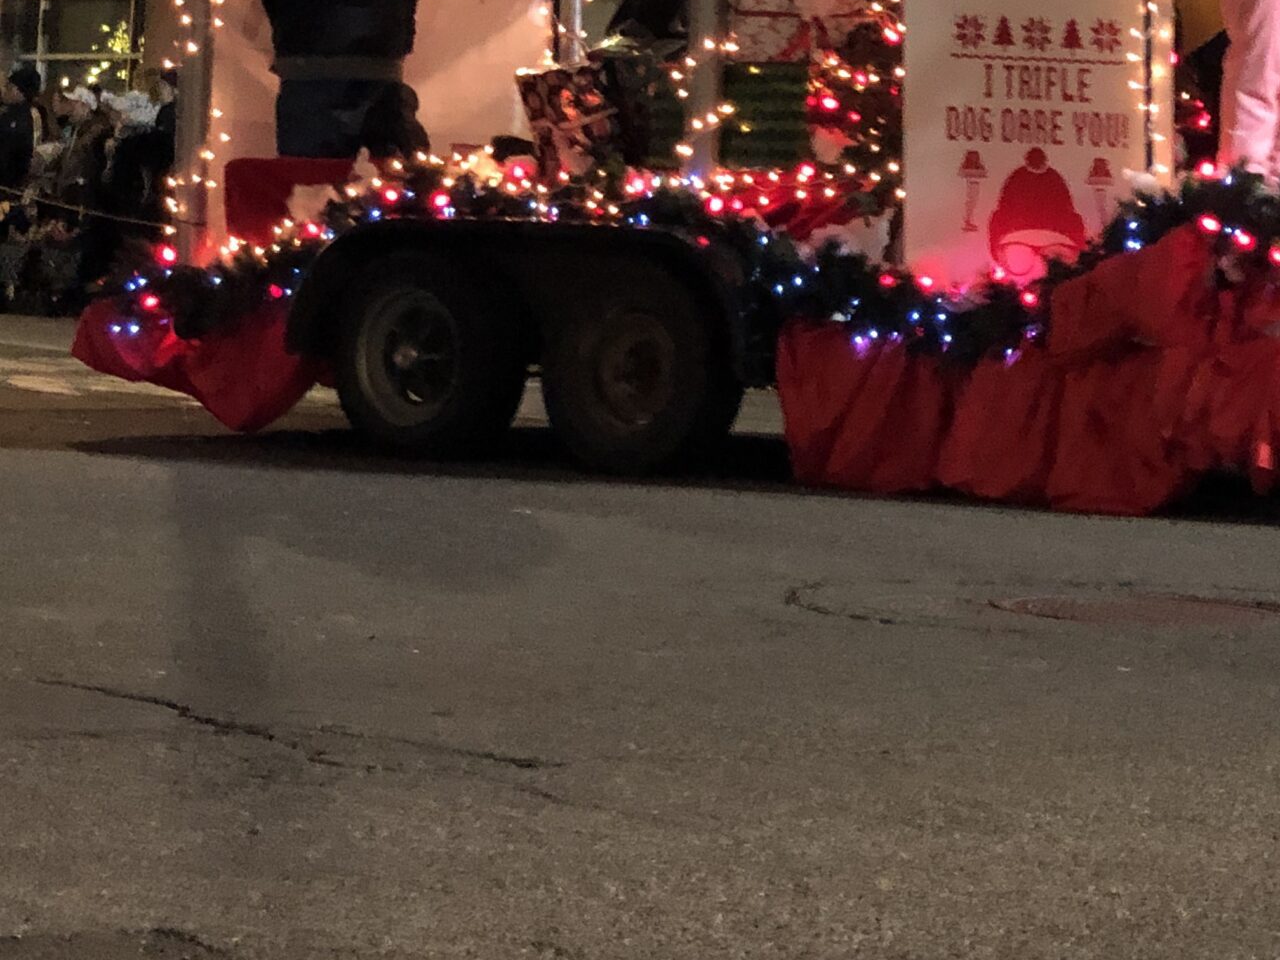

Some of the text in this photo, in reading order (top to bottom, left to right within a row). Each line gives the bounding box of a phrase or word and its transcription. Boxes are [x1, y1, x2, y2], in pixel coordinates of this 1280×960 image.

[983, 64, 994, 99] I
[945, 106, 993, 142] DOG
[1071, 112, 1130, 148] YOU!
